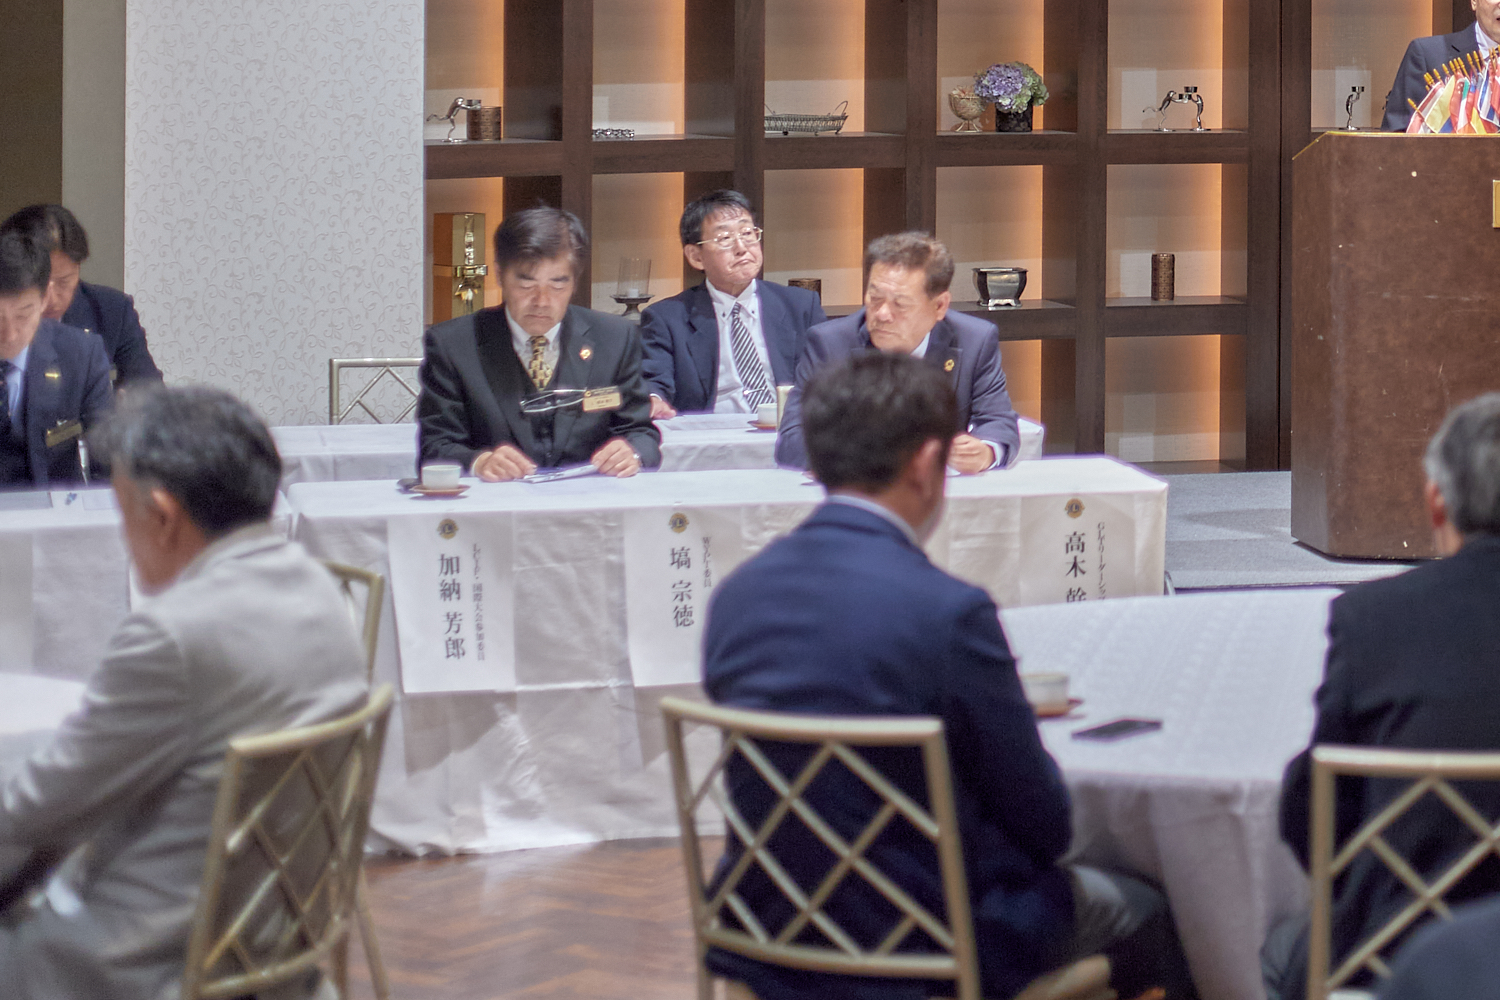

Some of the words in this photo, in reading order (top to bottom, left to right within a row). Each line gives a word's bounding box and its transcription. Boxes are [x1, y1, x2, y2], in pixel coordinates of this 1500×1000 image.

[438, 553, 460, 602] 加納
[1065, 531, 1087, 578] 高木
[442, 611, 466, 660] 芳郎
